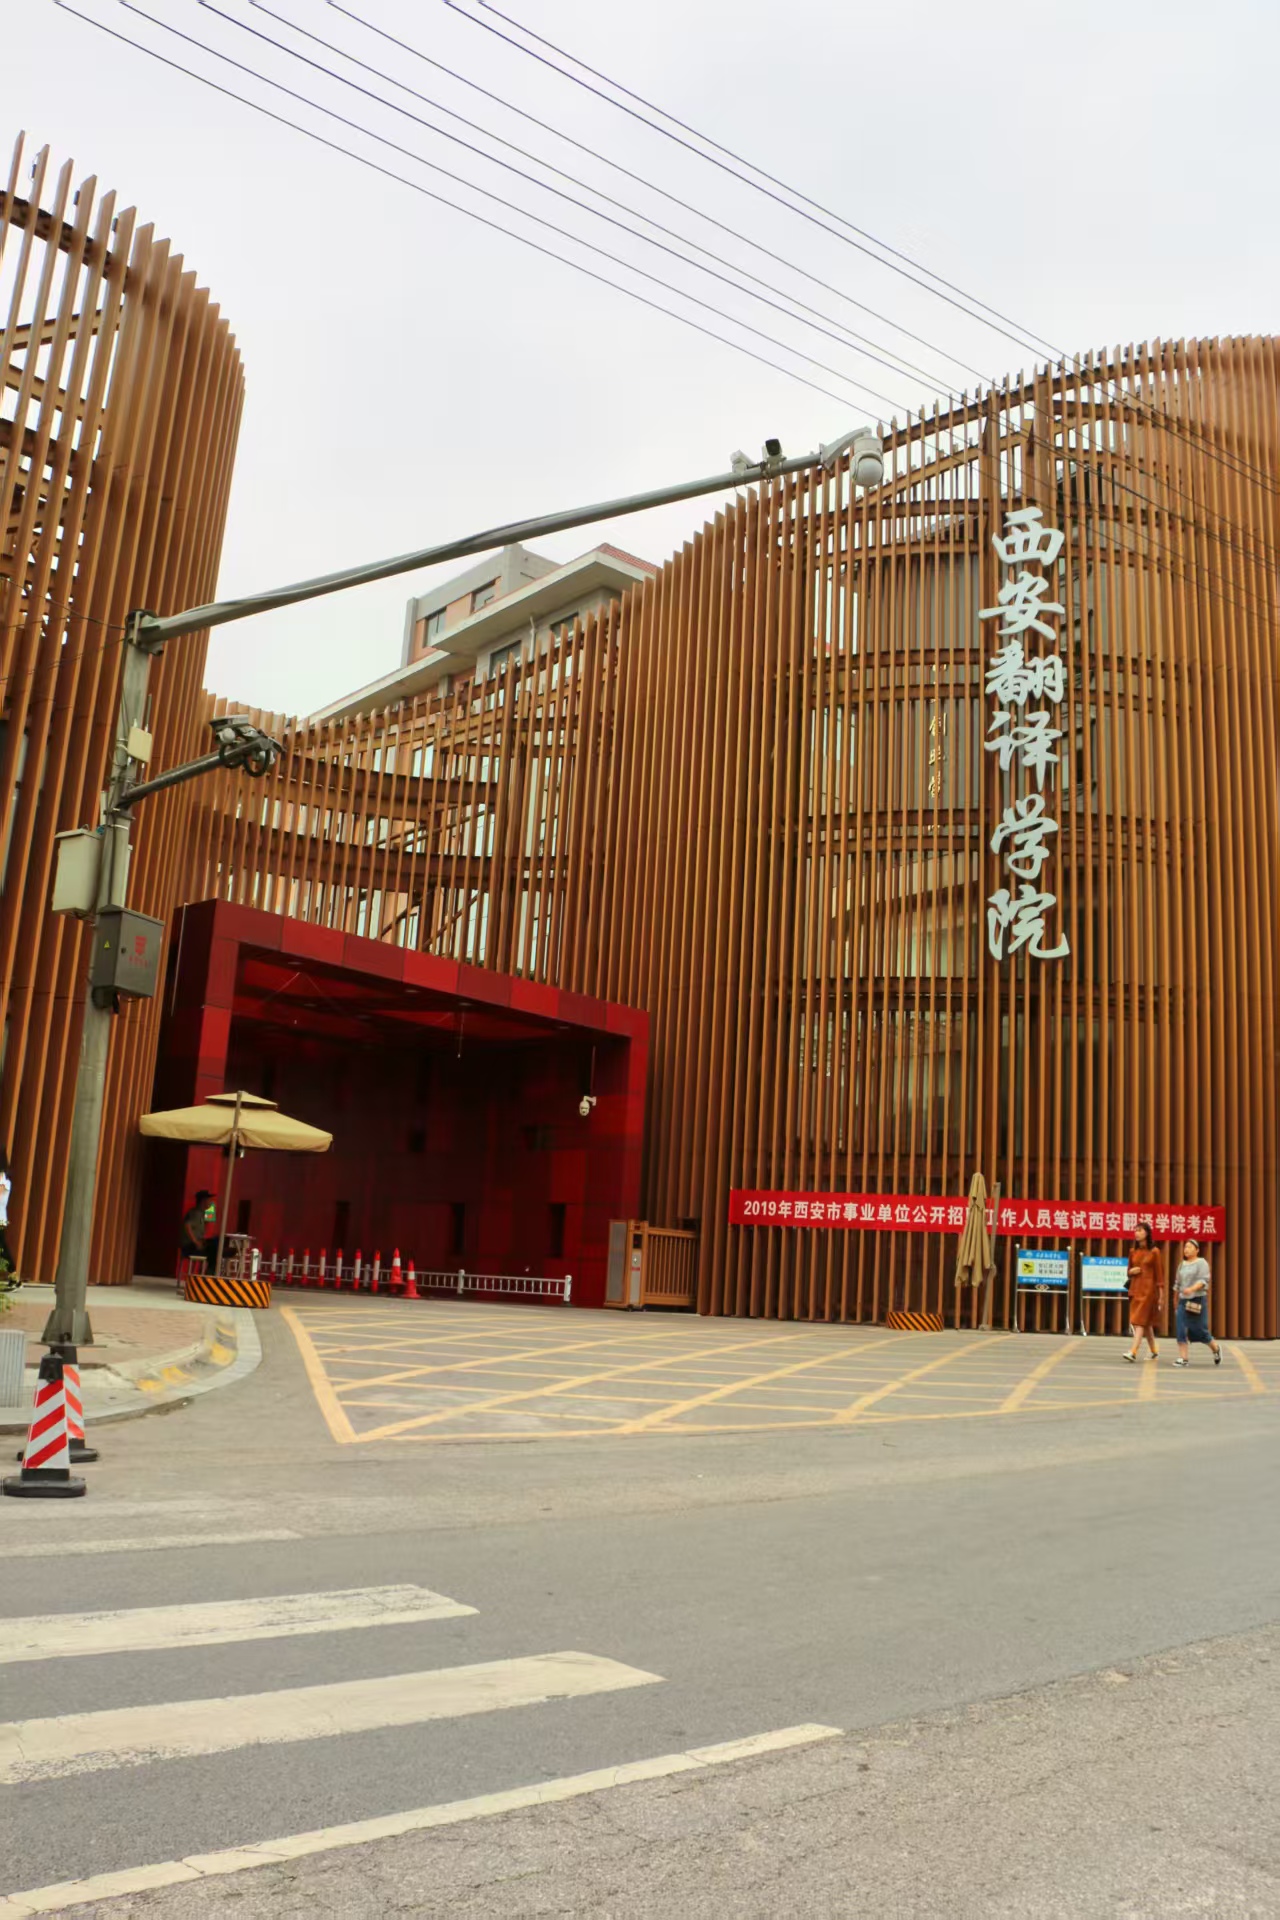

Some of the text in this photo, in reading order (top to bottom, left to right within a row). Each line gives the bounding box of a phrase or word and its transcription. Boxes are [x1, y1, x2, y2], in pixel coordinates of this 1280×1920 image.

[978, 506, 1070, 961] 西安翻译学院
[743, 1200, 1217, 1234] 2019年西安市事业单位公开招工作人员笔试西安翻译学院考点
